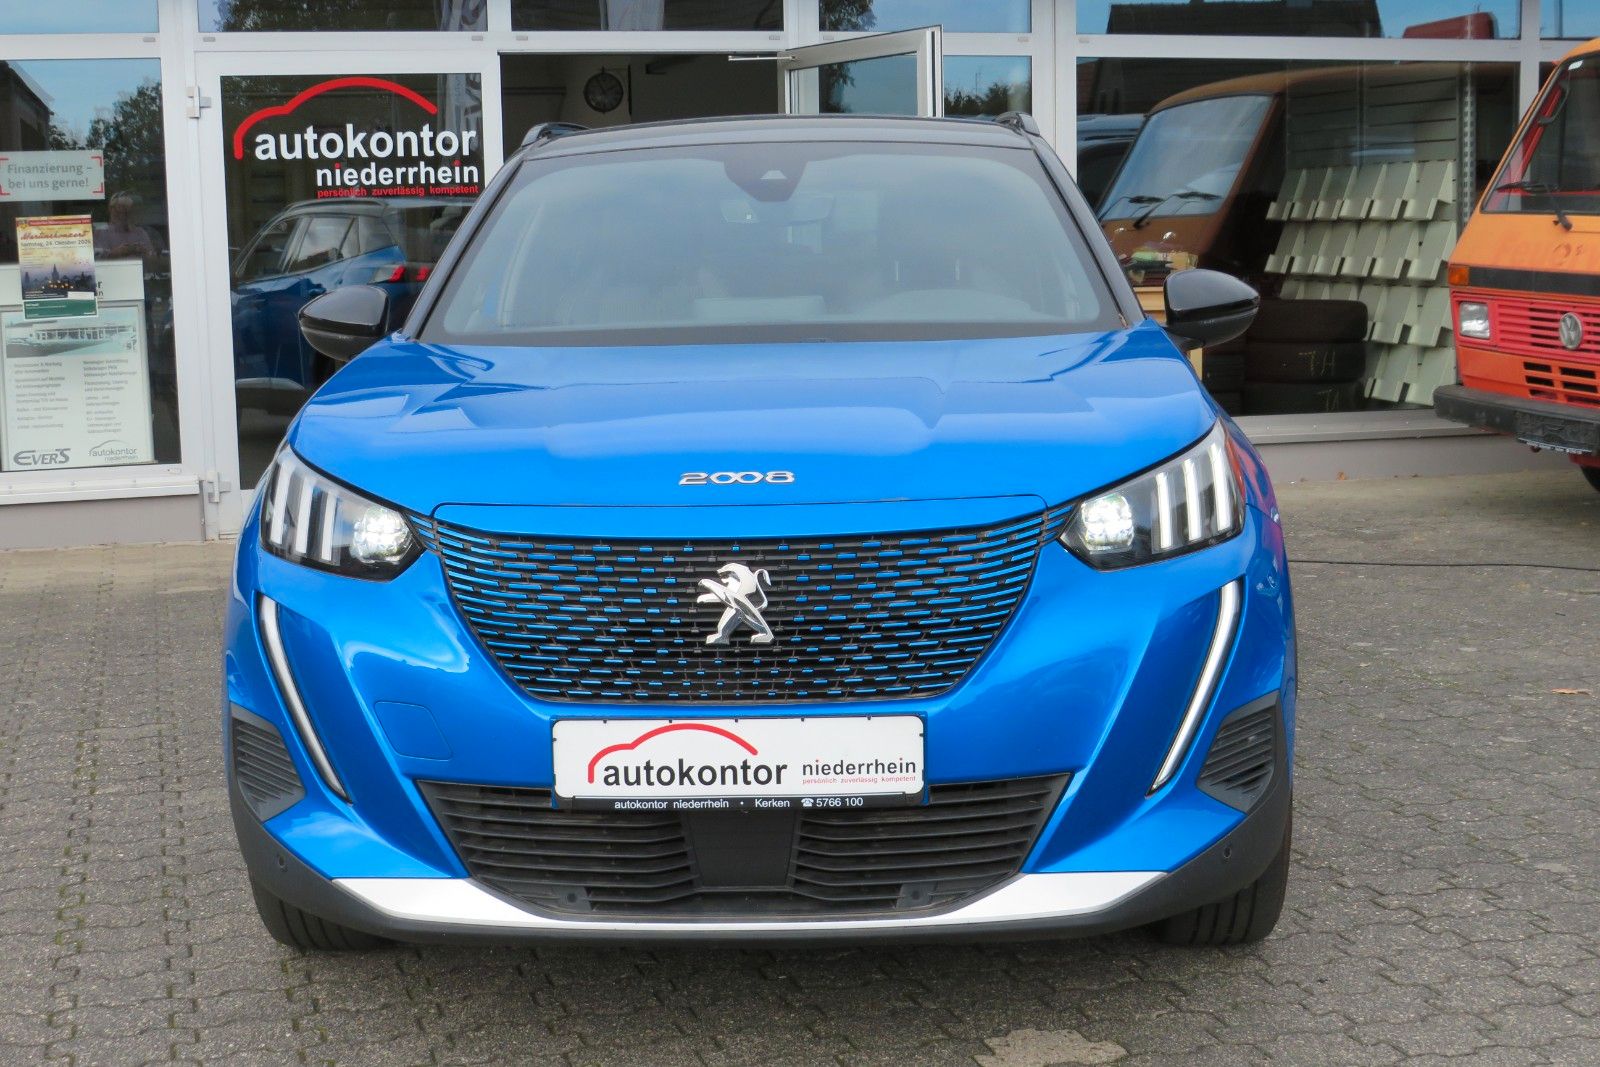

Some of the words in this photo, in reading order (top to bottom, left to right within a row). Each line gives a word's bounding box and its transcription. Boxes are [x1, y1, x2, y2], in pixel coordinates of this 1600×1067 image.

[255, 123, 477, 161] autokontor
[7, 163, 84, 176] Finanzierung
[316, 160, 479, 187] niederrhein
[8, 179, 26, 189] bei
[29, 180, 50, 188] uns
[52, 178, 90, 190] gerne!
[317, 188, 367, 199] persönlich
[371, 186, 425, 198] zuverlässig
[430, 185, 479, 196] kompetent
[678, 471, 795, 486] 2008
[603, 758, 788, 786] autokontor
[802, 757, 916, 777] niederrhein
[802, 776, 837, 786] persönlich
[840, 776, 878, 785] zuverlässig
[881, 775, 916, 783] kompetent
[614, 799, 668, 810] autokontor
[673, 798, 729, 809] niederrhein
[755, 798, 790, 808] Kerken
[816, 797, 841, 807] 5766
[845, 797, 864, 807] 100
